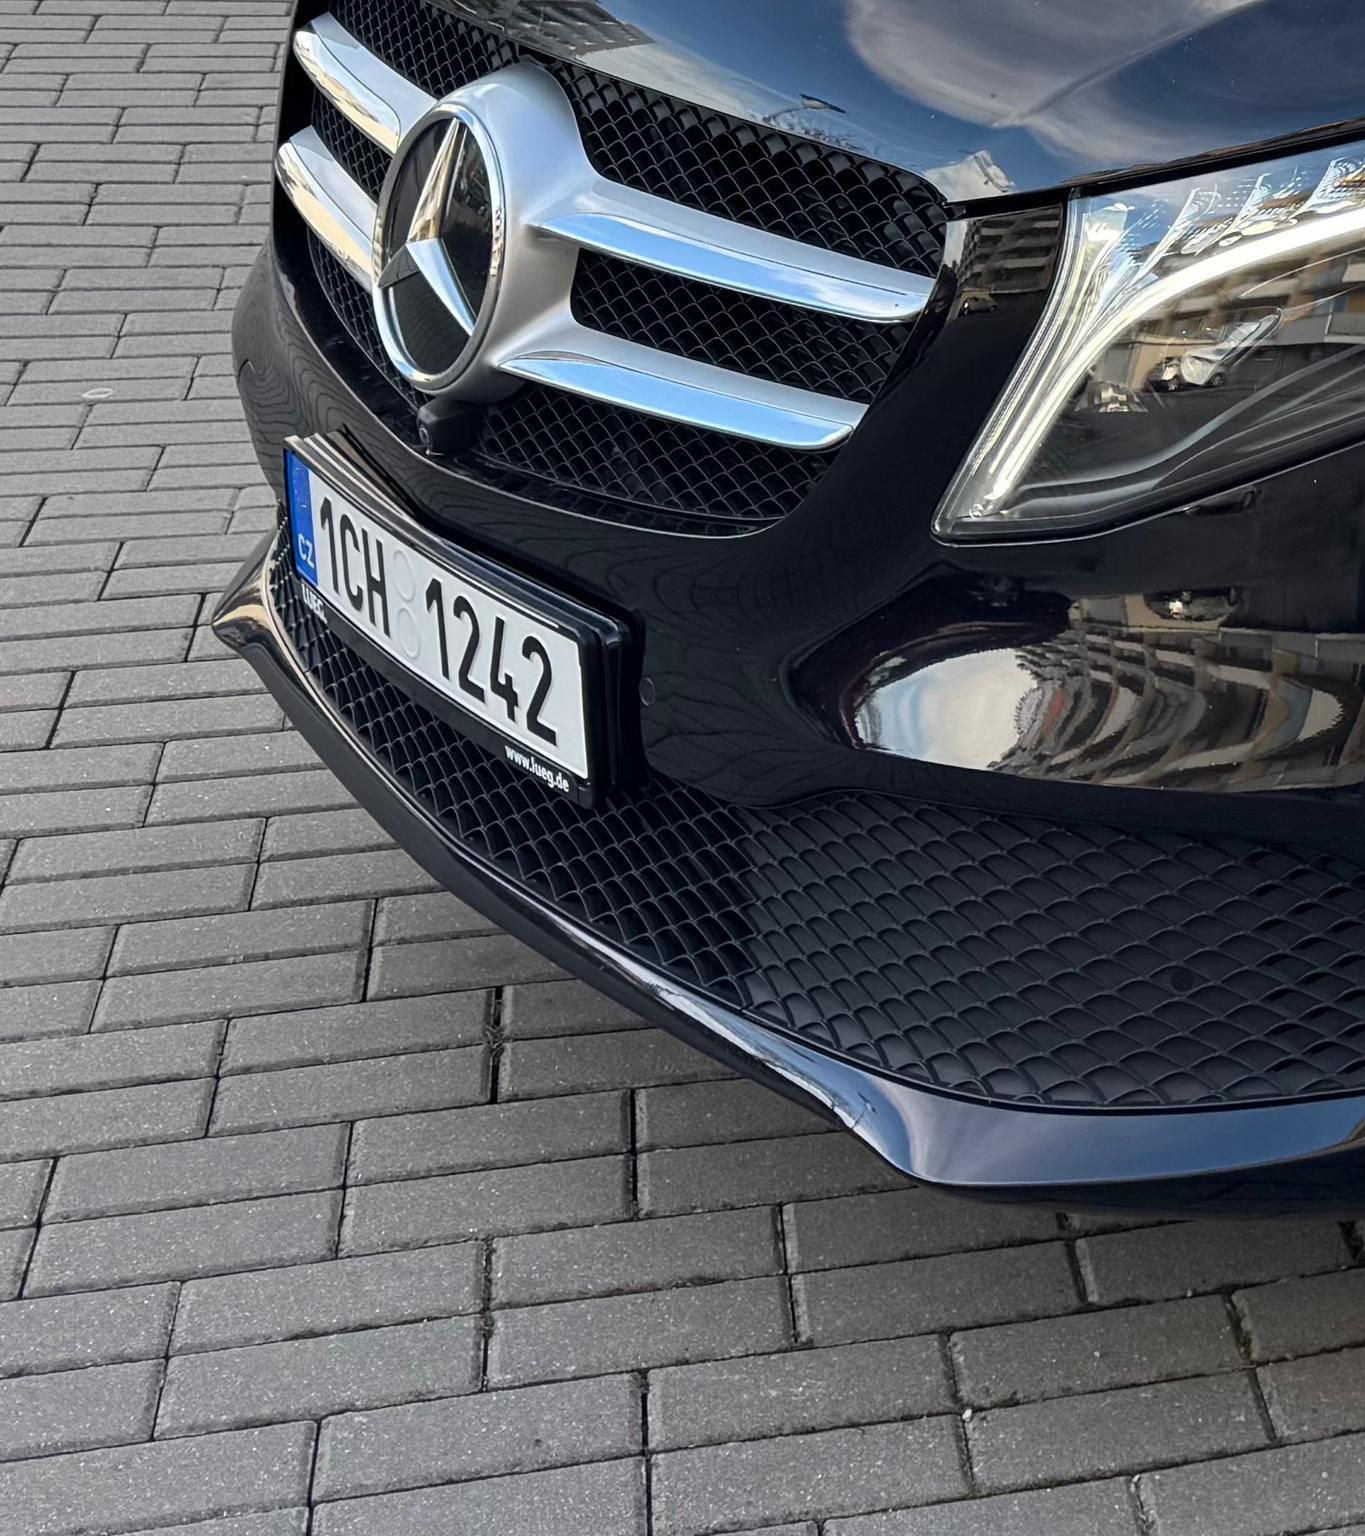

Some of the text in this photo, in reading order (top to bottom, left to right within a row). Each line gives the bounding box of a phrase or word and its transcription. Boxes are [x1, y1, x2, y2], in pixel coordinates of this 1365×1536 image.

[298, 533, 315, 569] CZ
[320, 497, 557, 746] 1CH 1242
[504, 745, 570, 793] www.lueg.de
